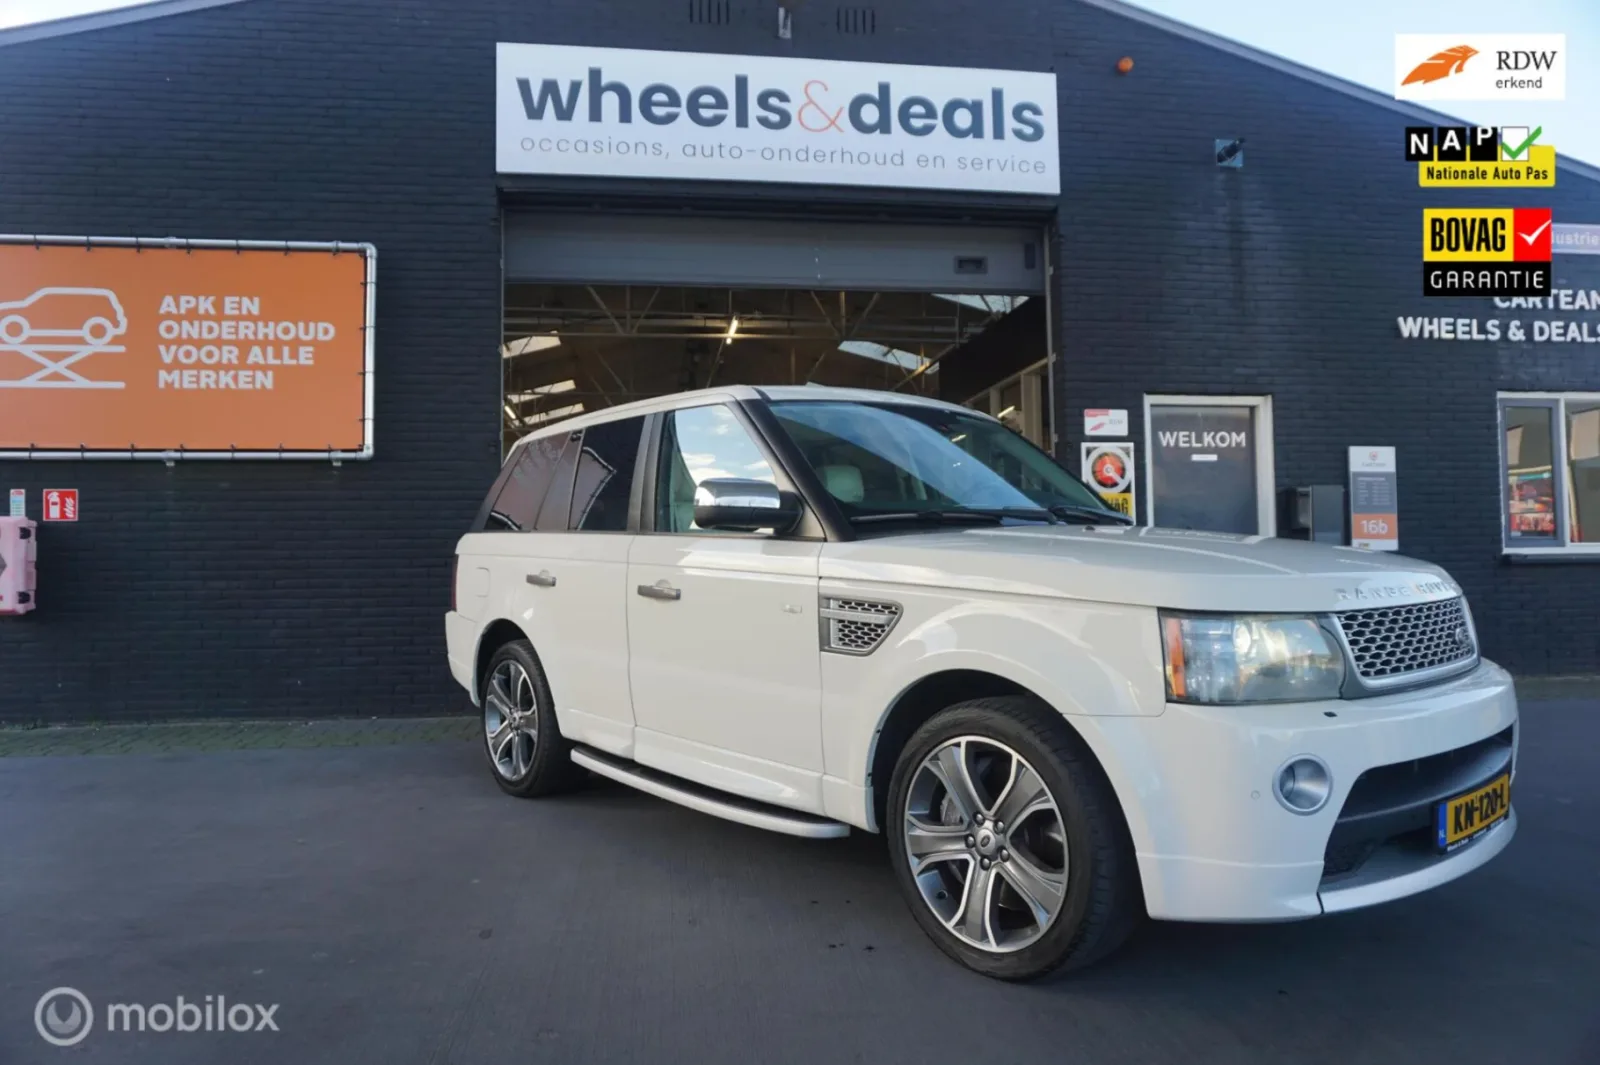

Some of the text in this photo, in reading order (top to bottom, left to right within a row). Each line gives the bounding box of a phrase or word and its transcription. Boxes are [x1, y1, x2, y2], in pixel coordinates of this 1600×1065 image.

[515, 66, 1045, 142] wheels&deals
[520, 136, 1046, 174] occasions, auto-onderhoud en service
[158, 295, 260, 316] APK EN
[158, 319, 336, 341] ONDERHOUD
[1397, 316, 1501, 341] WHEELS
[1507, 319, 1526, 341] &
[158, 345, 315, 366] VOOR ALLE
[158, 369, 274, 390] MERKEN
[1158, 431, 1246, 448] WELKOM
[1360, 518, 1389, 535] 16b
